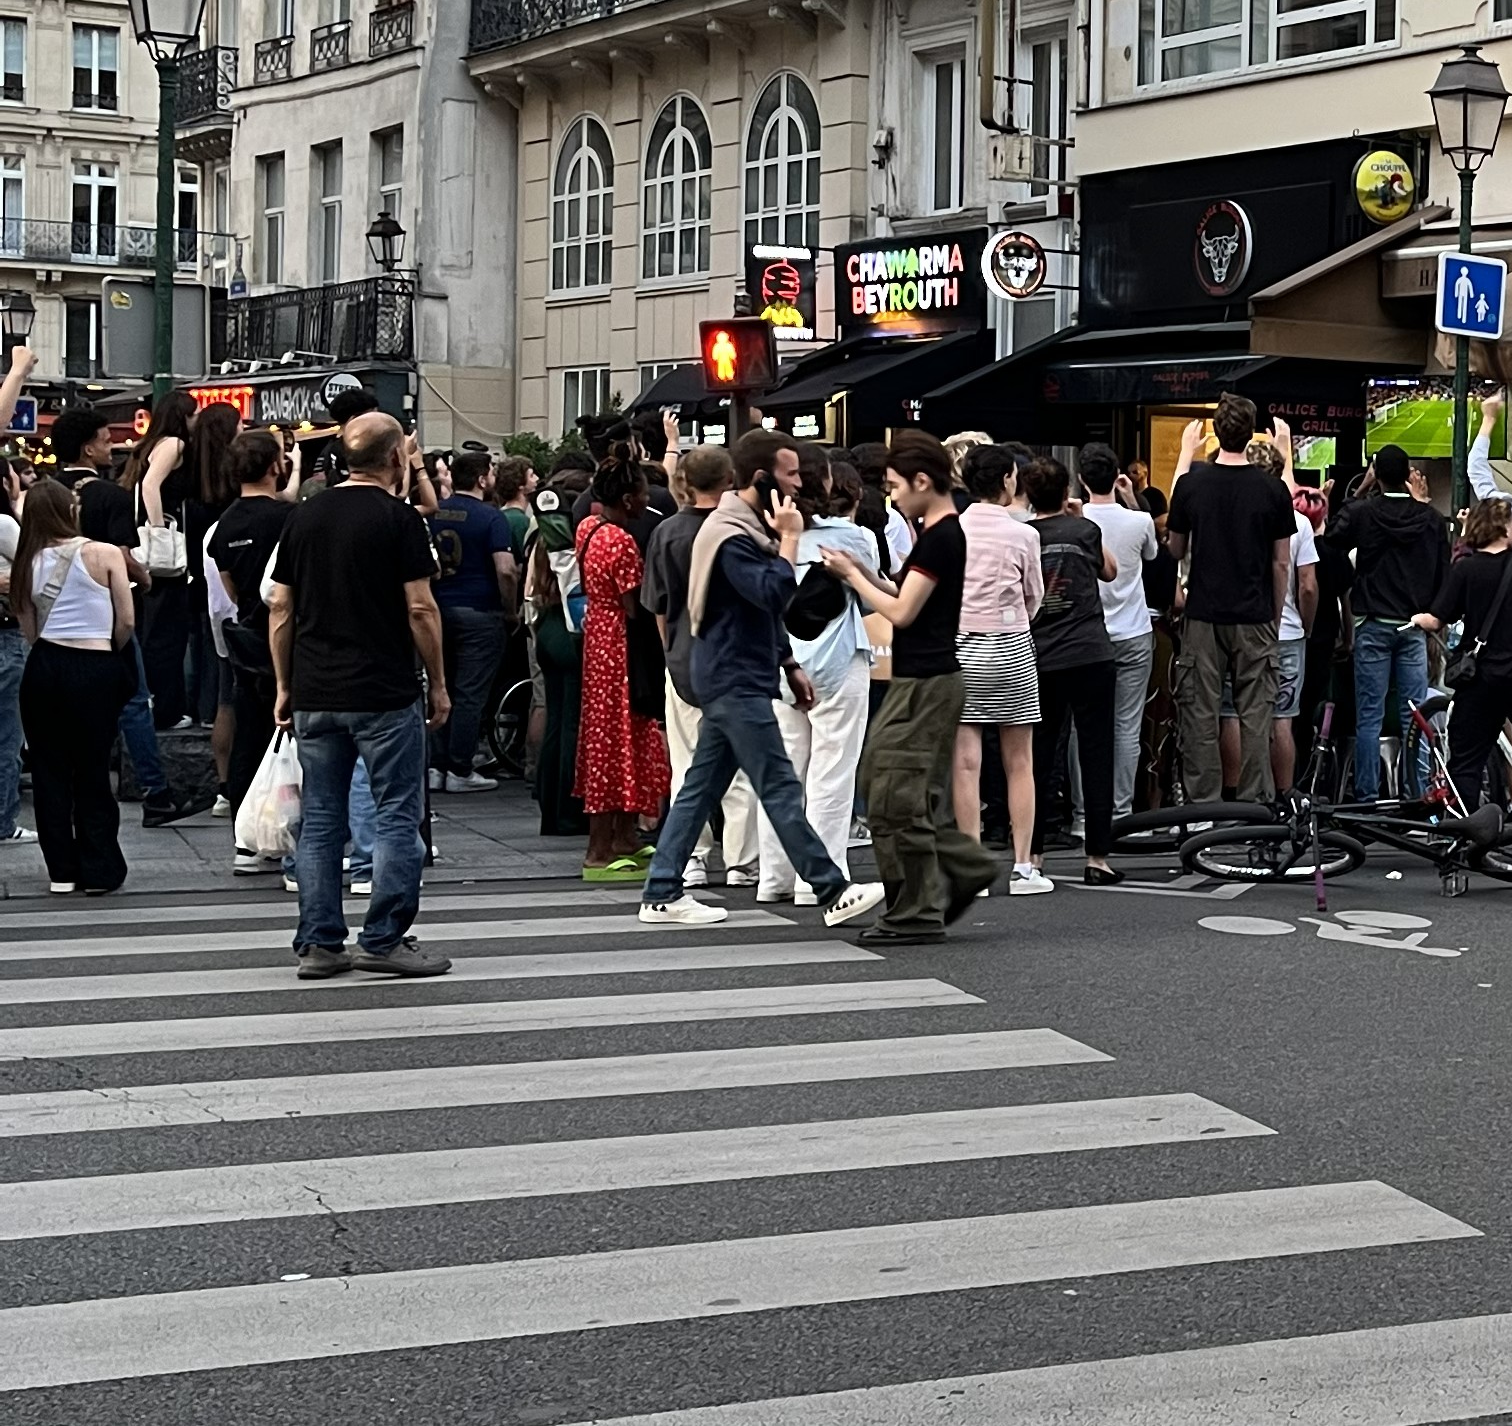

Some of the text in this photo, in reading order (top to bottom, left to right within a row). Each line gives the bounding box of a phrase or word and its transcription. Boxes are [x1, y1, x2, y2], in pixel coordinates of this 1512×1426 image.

[852, 277, 959, 315] BEYROUTH
[1268, 403, 1318, 416] GALICE
[1301, 420, 1341, 432] GRILL
